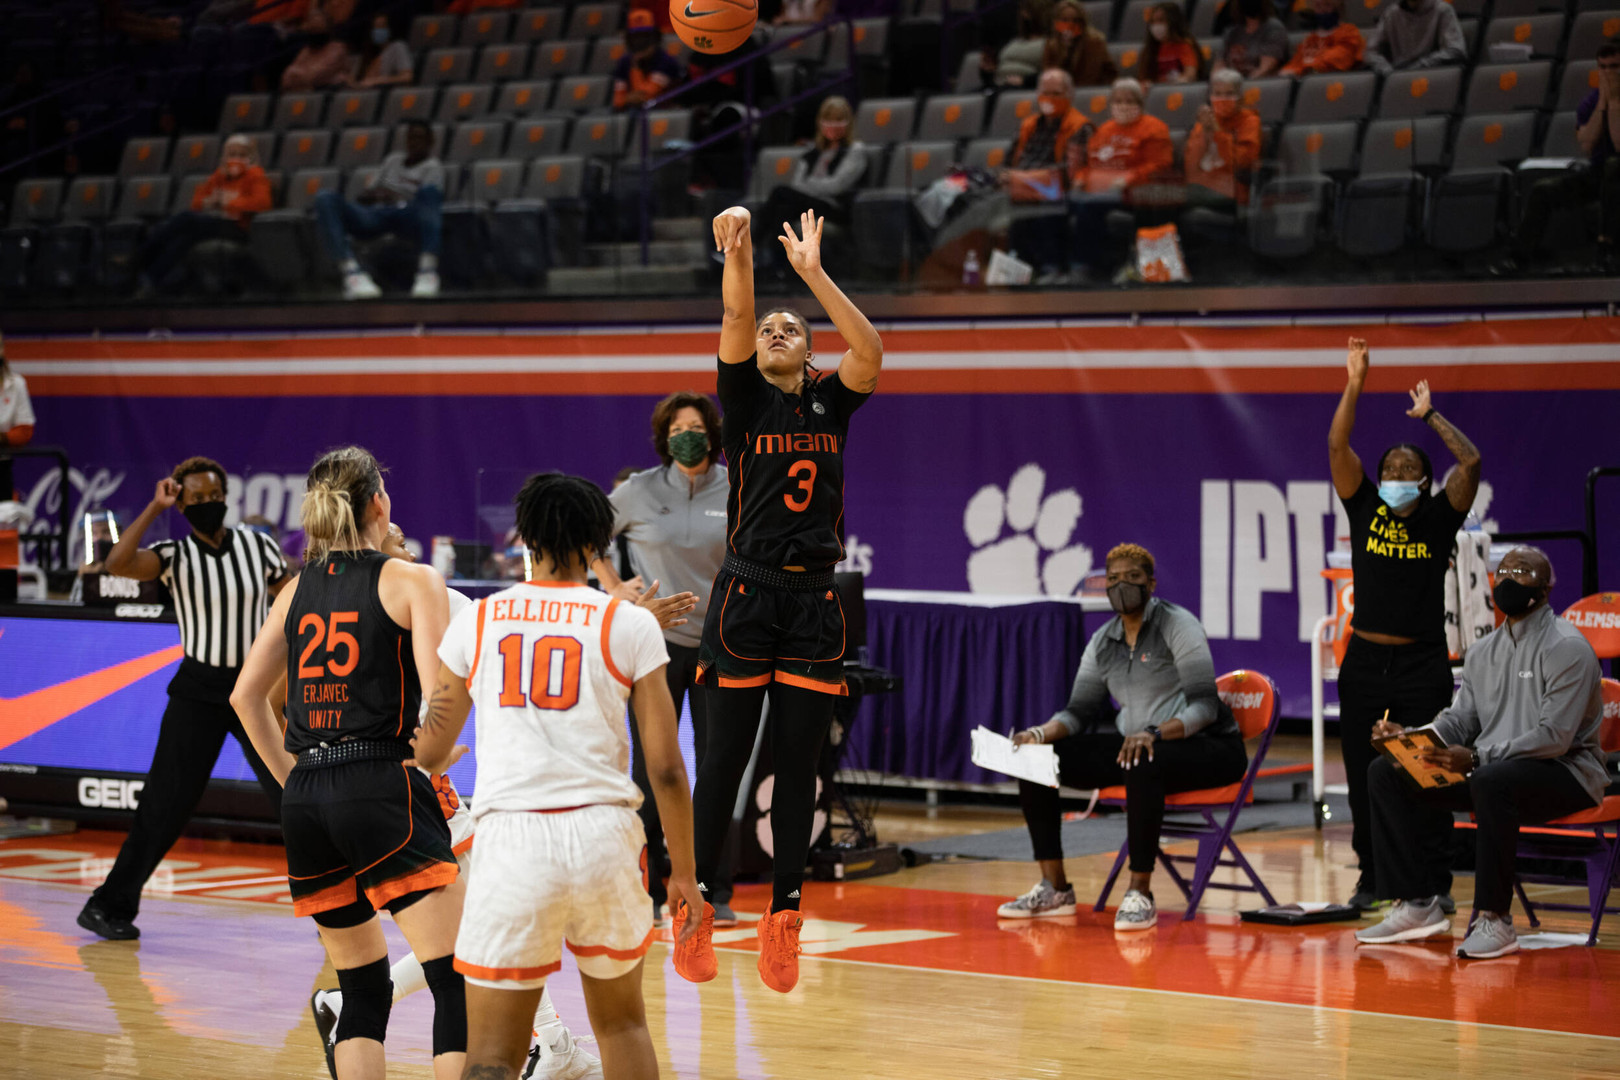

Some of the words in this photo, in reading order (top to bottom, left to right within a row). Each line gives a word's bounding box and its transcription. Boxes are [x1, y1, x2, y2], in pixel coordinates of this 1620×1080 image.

[783, 459, 818, 513] 3
[1366, 536, 1432, 559] MATTER.
[492, 598, 598, 626] ELLIOTT
[298, 611, 360, 679] 25
[498, 633, 583, 711] 10
[303, 683, 349, 704] ERJAVEC
[308, 709, 342, 729] UNITY
[78, 777, 145, 810] GEIC
